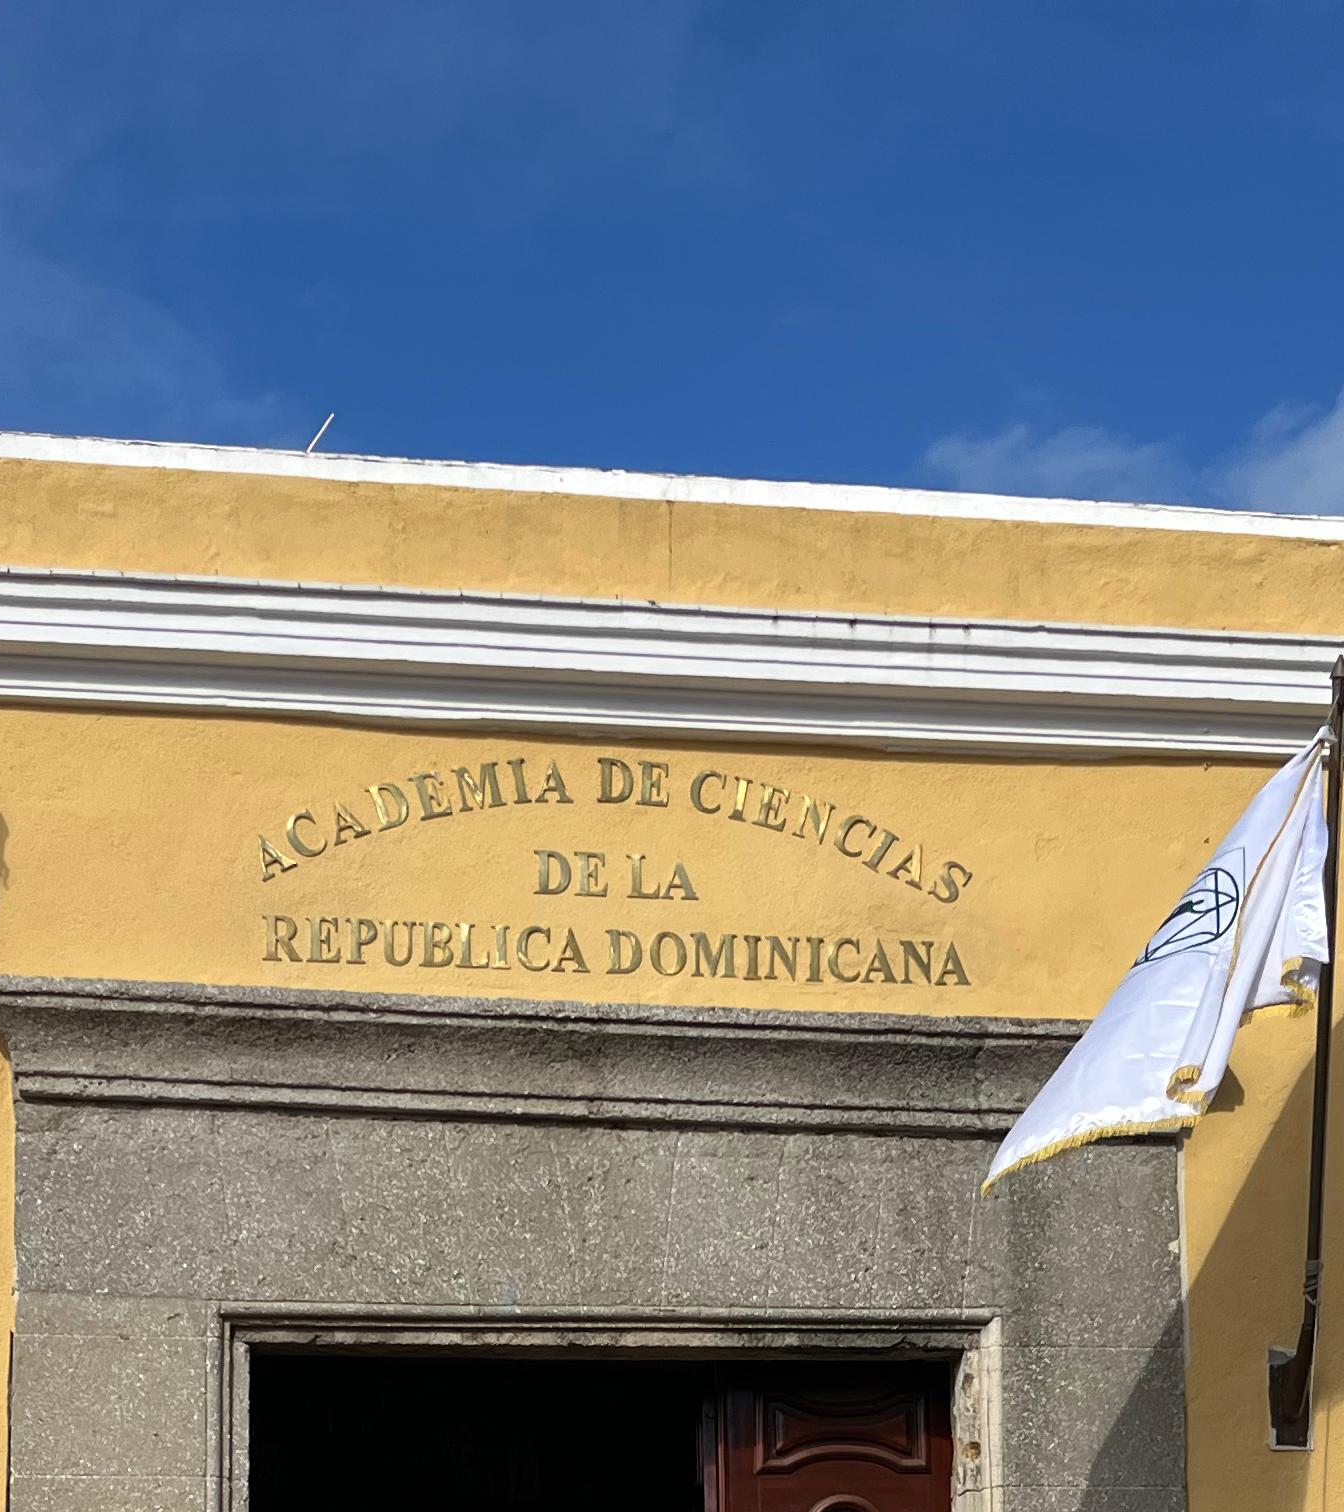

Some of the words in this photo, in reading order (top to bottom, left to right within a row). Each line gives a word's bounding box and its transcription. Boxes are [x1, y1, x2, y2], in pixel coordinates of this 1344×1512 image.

[257, 757, 574, 883] ACADEMIA
[596, 756, 669, 807] DE
[690, 769, 973, 904] CIENCIAS
[533, 849, 608, 897] DE
[625, 853, 699, 901] LA
[261, 914, 591, 973] REPUBLICA
[605, 928, 971, 986] DOMINICANA
